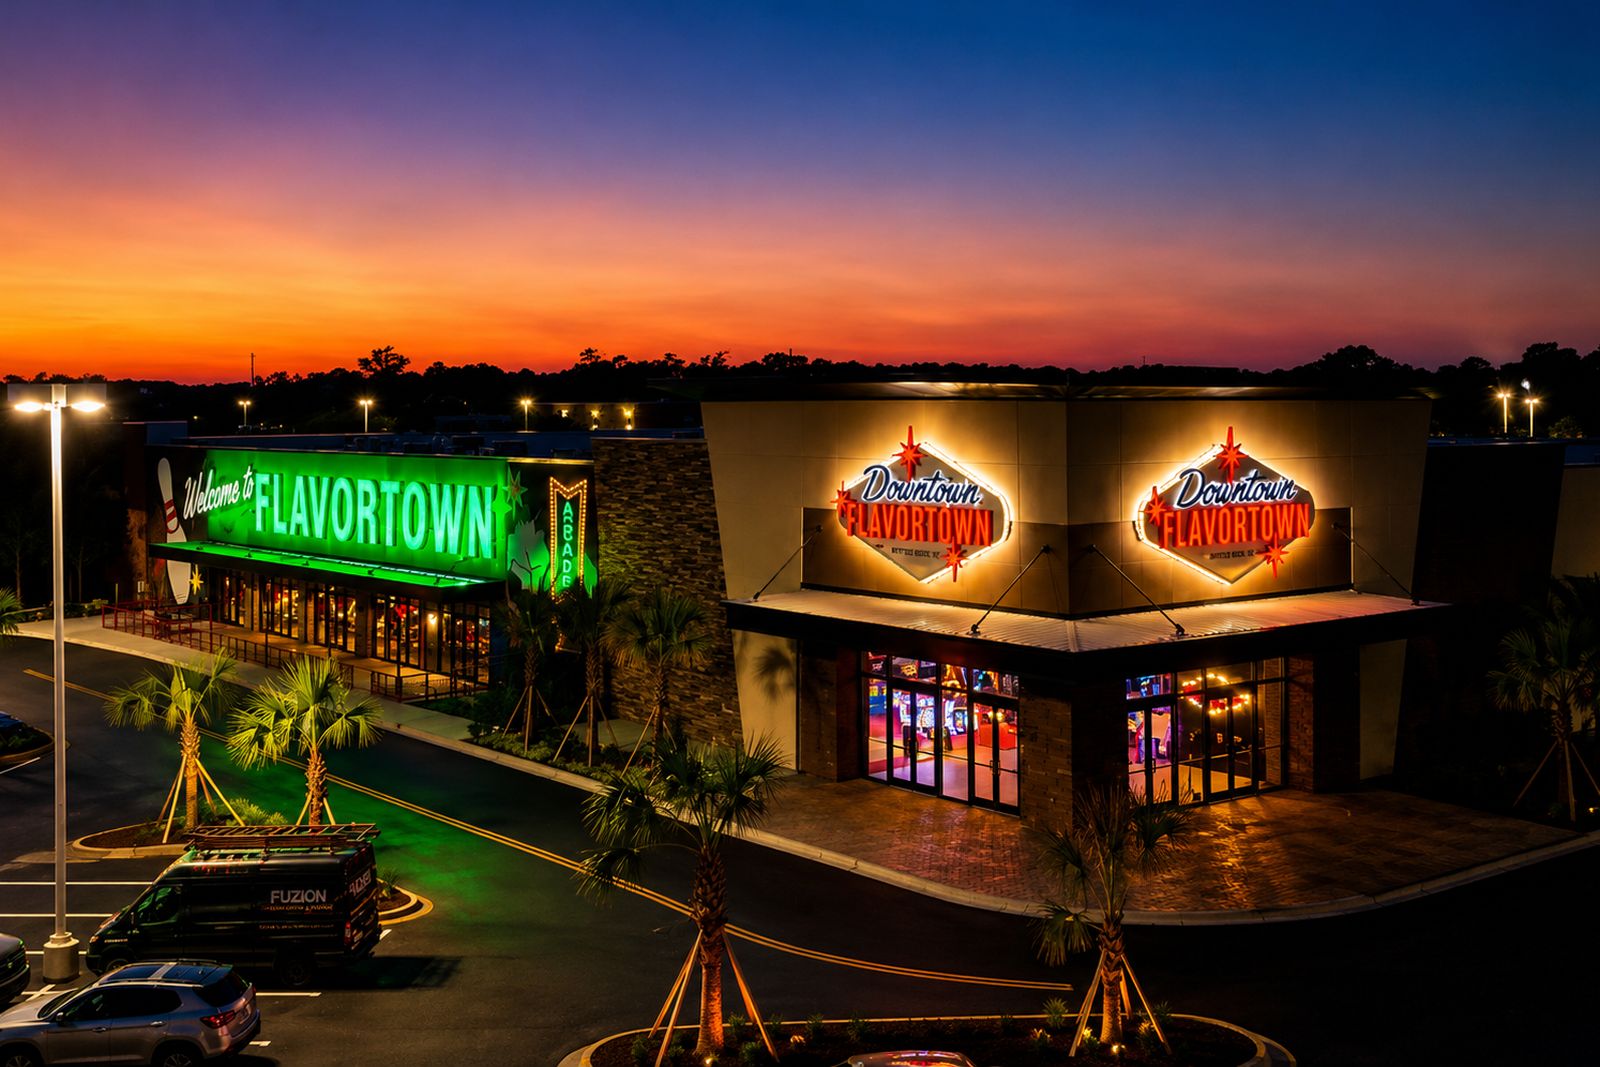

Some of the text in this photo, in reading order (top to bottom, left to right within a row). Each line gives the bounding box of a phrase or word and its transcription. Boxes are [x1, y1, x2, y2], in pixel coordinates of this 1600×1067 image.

[183, 465, 255, 520] Welcome to
[861, 465, 983, 507] Downtown
[1174, 468, 1299, 509] Downtown
[255, 472, 493, 559] FLAVORTOWN
[846, 502, 993, 547] FLAVORTOWN
[1161, 503, 1311, 550] FLAVORTOWN
[270, 889, 327, 904] FUZION
